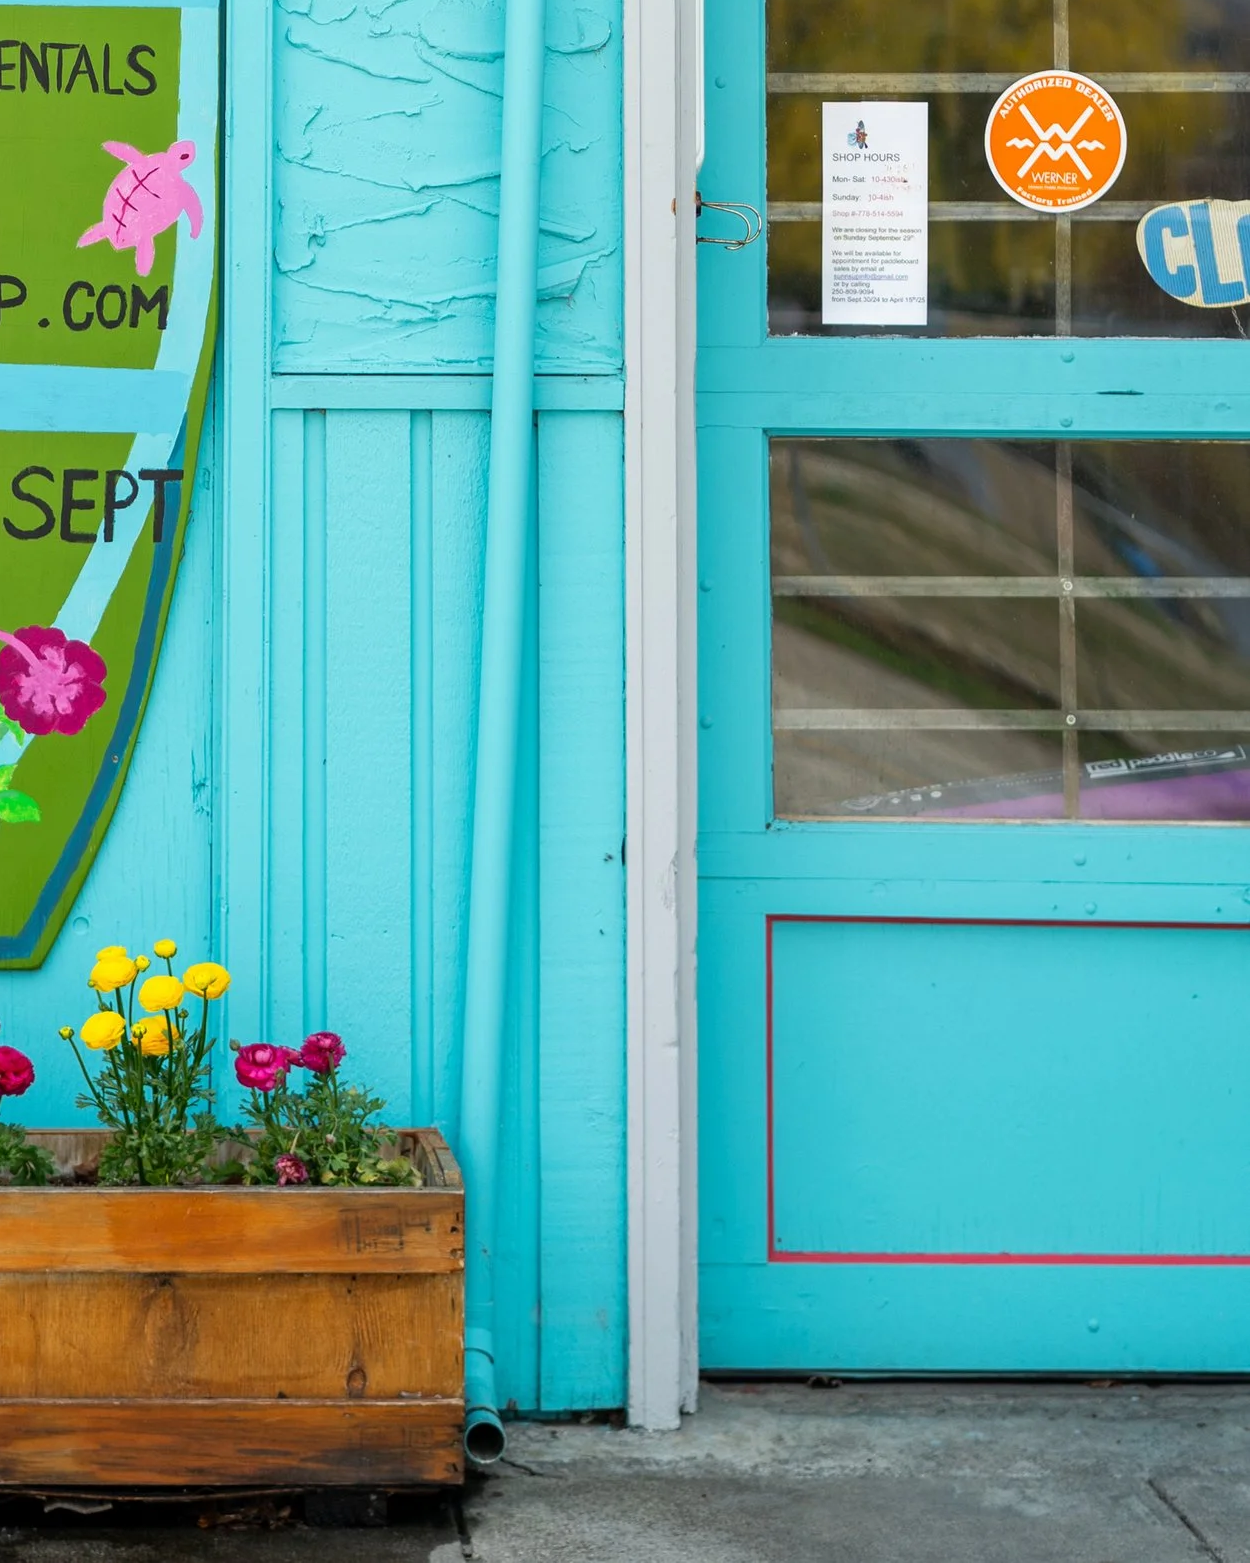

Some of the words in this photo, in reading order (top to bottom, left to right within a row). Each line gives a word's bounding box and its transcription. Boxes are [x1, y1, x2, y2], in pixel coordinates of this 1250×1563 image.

[999, 78, 1072, 119] AUTHORIZED
[1075, 83, 1115, 122] DEALER
[832, 153, 861, 162] SHOP
[864, 153, 901, 162] HOURS
[1031, 171, 1078, 185] WERNER
[832, 193, 861, 202] Sunday:
[1016, 186, 1053, 207] Factory
[1057, 188, 1093, 206] Trained
[843, 234, 866, 242] Sunday
[868, 234, 901, 242] September
[1144, 203, 1250, 305] CL
[889, 296, 904, 304] April
[4, 465, 184, 543] SEPT
